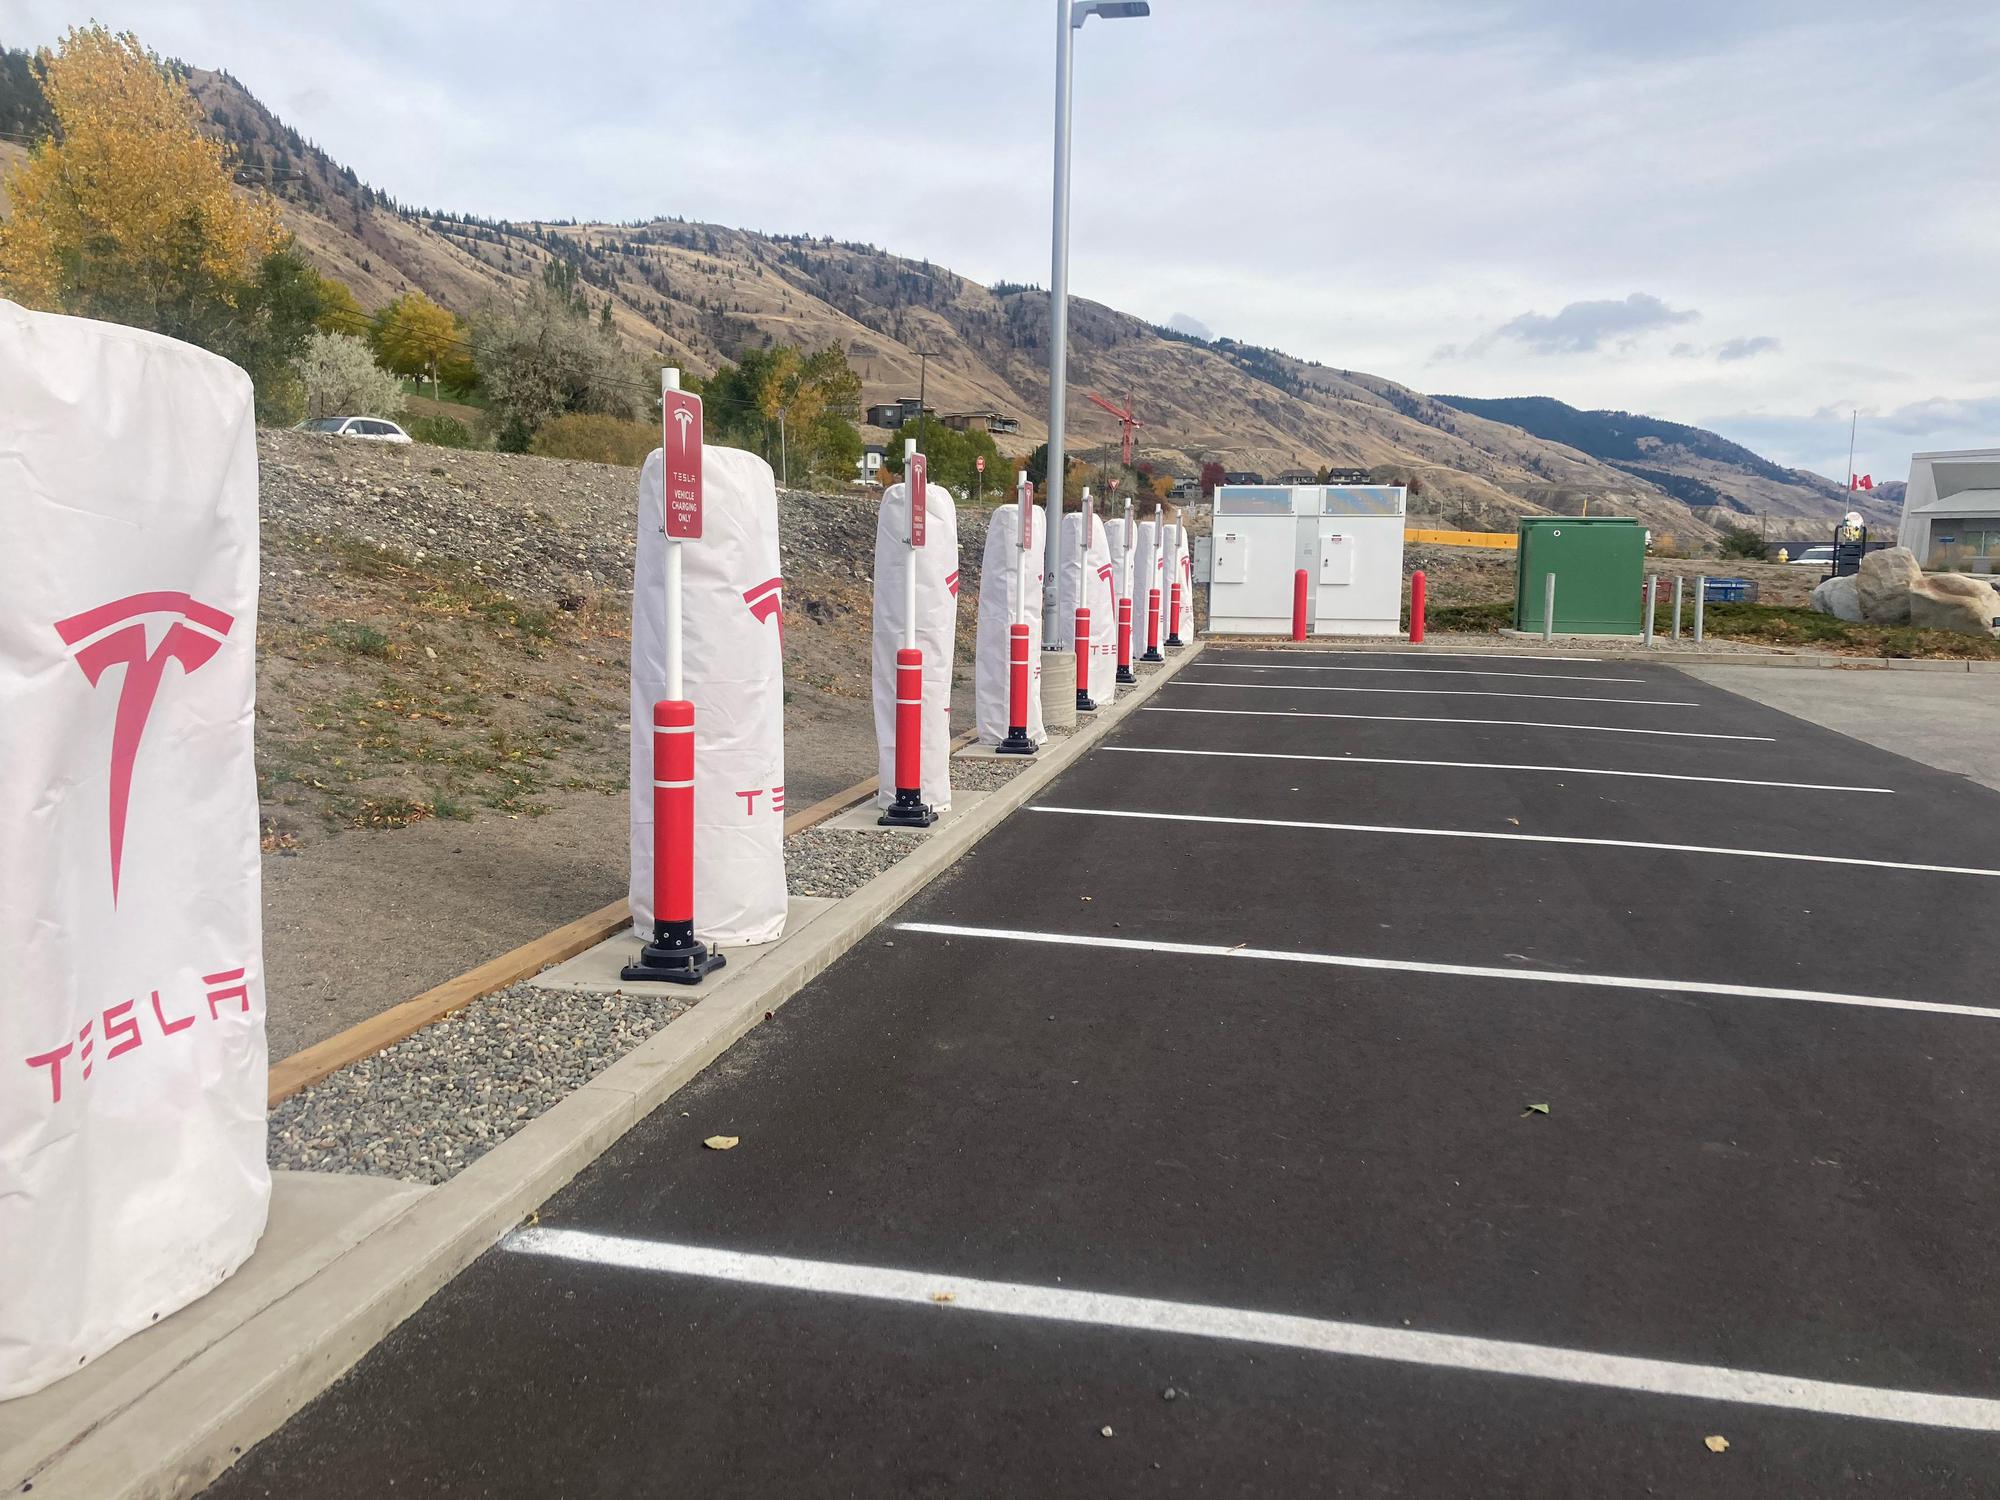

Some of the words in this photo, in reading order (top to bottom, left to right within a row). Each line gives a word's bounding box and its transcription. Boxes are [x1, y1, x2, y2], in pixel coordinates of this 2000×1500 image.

[673, 472, 696, 483] TESLA
[674, 490, 695, 501] VEHICLE
[672, 501, 697, 512] CHARGING
[678, 513, 692, 523] ONLY
[25, 967, 249, 1103] TESLA
